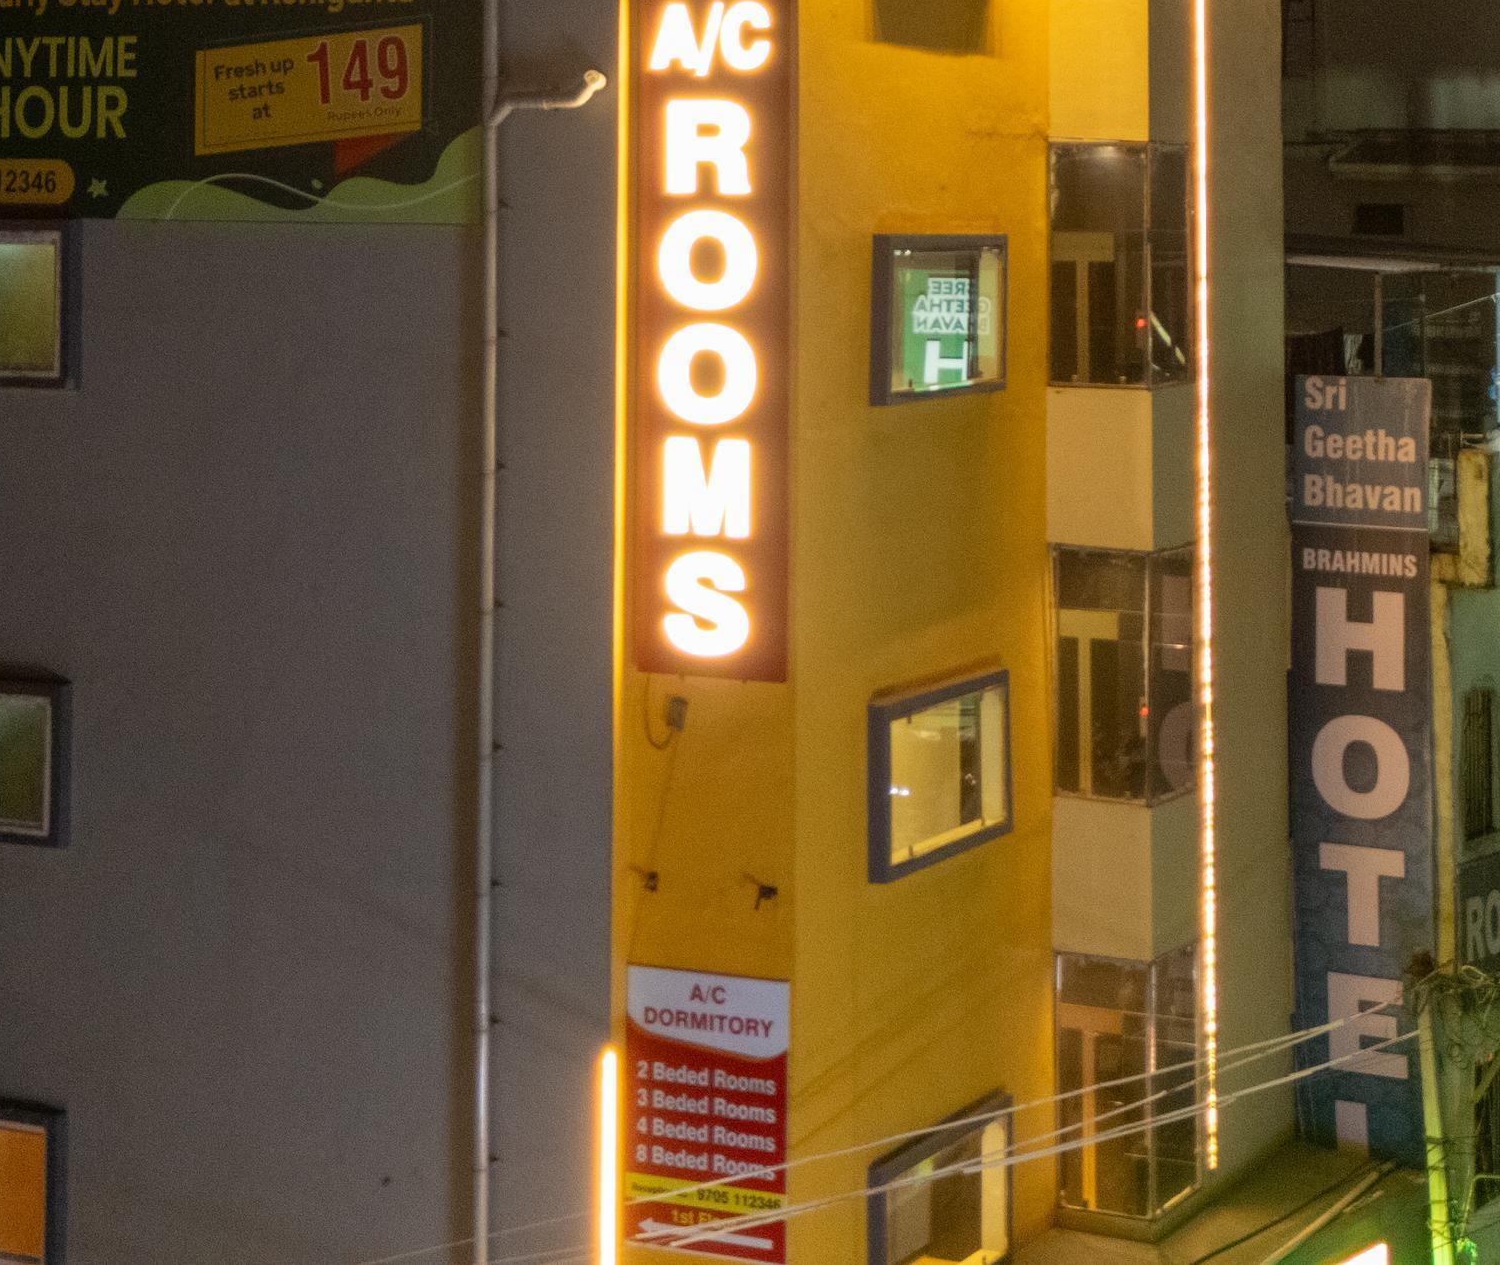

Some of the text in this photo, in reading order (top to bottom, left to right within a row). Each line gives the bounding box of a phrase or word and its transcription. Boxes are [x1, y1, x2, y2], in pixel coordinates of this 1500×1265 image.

[649, 0, 773, 77] A/C
[213, 56, 295, 81] Fresh up
[306, 35, 410, 106] 149
[227, 79, 286, 102] starts
[252, 101, 273, 121] at
[374, 105, 401, 119] Only
[655, 97, 759, 659] ROOMS
[1304, 375, 1348, 412] Sri
[1304, 424, 1417, 463] Geetha
[1304, 473, 1423, 513] Bhavan
[1302, 547, 1419, 578] BRAHMINS
[689, 983, 728, 1005] A/C
[643, 1005, 774, 1037] DORMITORY
[636, 1059, 777, 1096] 2 Beded Rooms
[636, 1088, 777, 1124] 3 Beded Rooms
[636, 1117, 777, 1153] 4 Beded Rooms
[636, 1144, 649, 1164] 8
[652, 1145, 709, 1172] Beded
